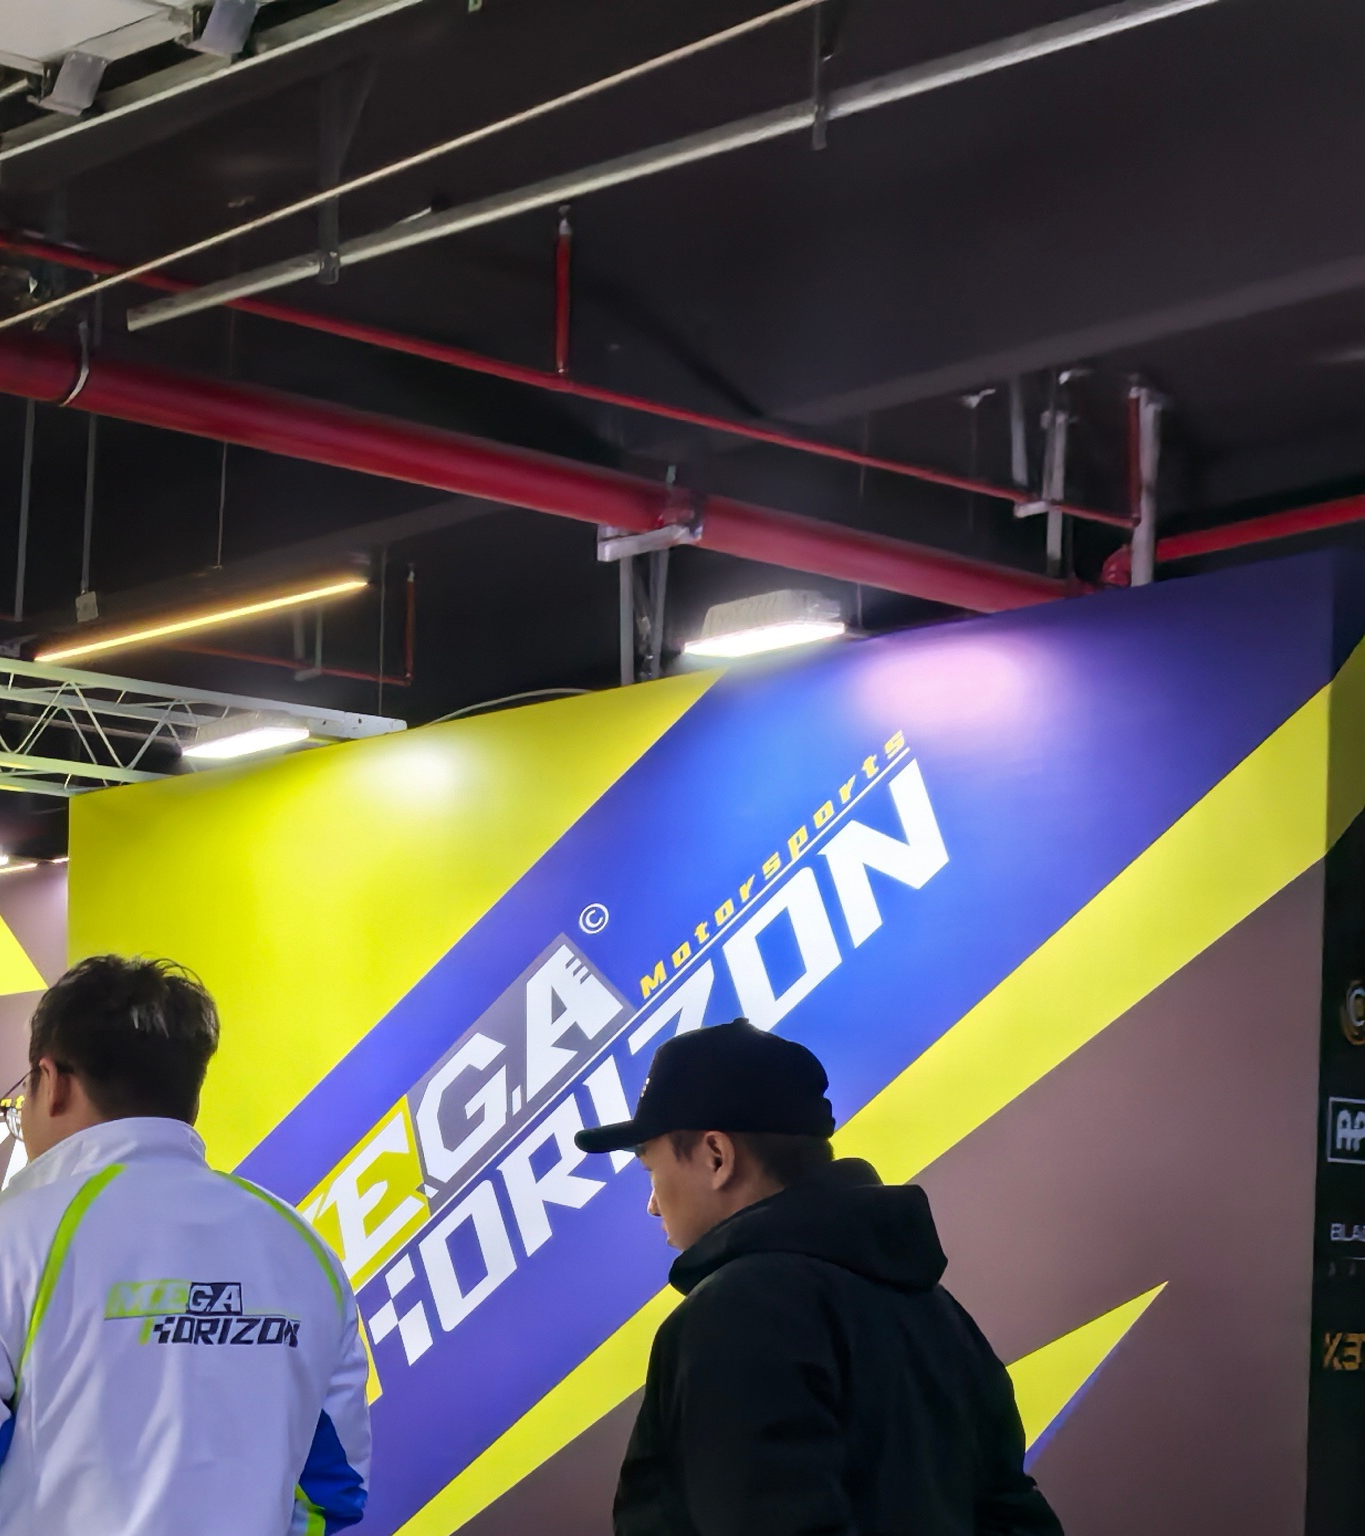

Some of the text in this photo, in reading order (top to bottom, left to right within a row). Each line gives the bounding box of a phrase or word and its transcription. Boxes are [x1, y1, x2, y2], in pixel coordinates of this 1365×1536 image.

[640, 731, 907, 998] Motorsports
[299, 944, 626, 1279] EGA
[107, 1283, 242, 1315] MEGA
[138, 1316, 300, 1348] HORIZON
